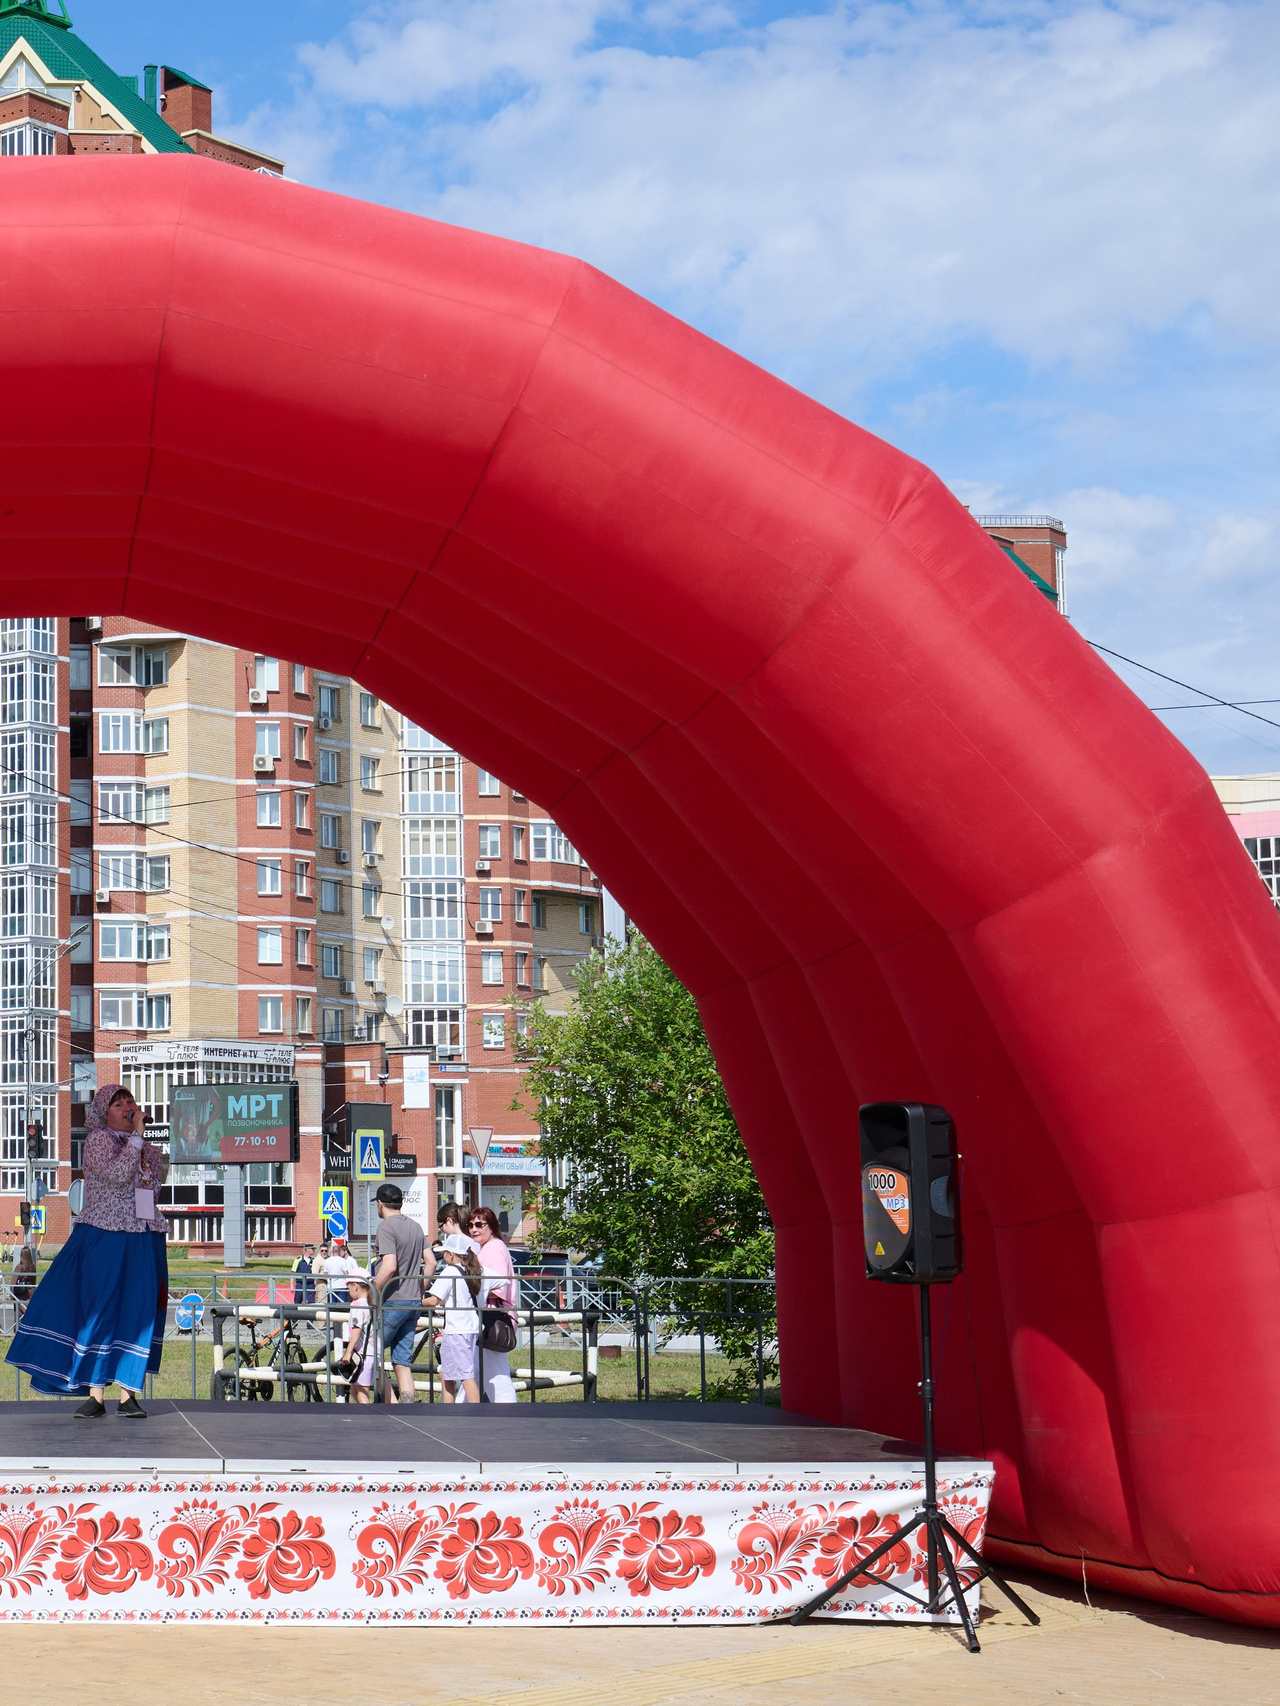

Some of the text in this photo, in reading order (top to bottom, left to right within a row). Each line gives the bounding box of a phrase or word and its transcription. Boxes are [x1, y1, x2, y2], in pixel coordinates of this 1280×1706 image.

[122, 1045, 154, 1053] ИНТЕРНЕТ
[204, 1047, 241, 1058] ИНТЕРНЕТ
[248, 1050, 258, 1059] TV
[227, 1094, 284, 1119] МРТ
[227, 1119, 283, 1127] ПОЗВОНОЧНИКА
[868, 1172, 896, 1191] 1000
[886, 1198, 906, 1209] MP3
